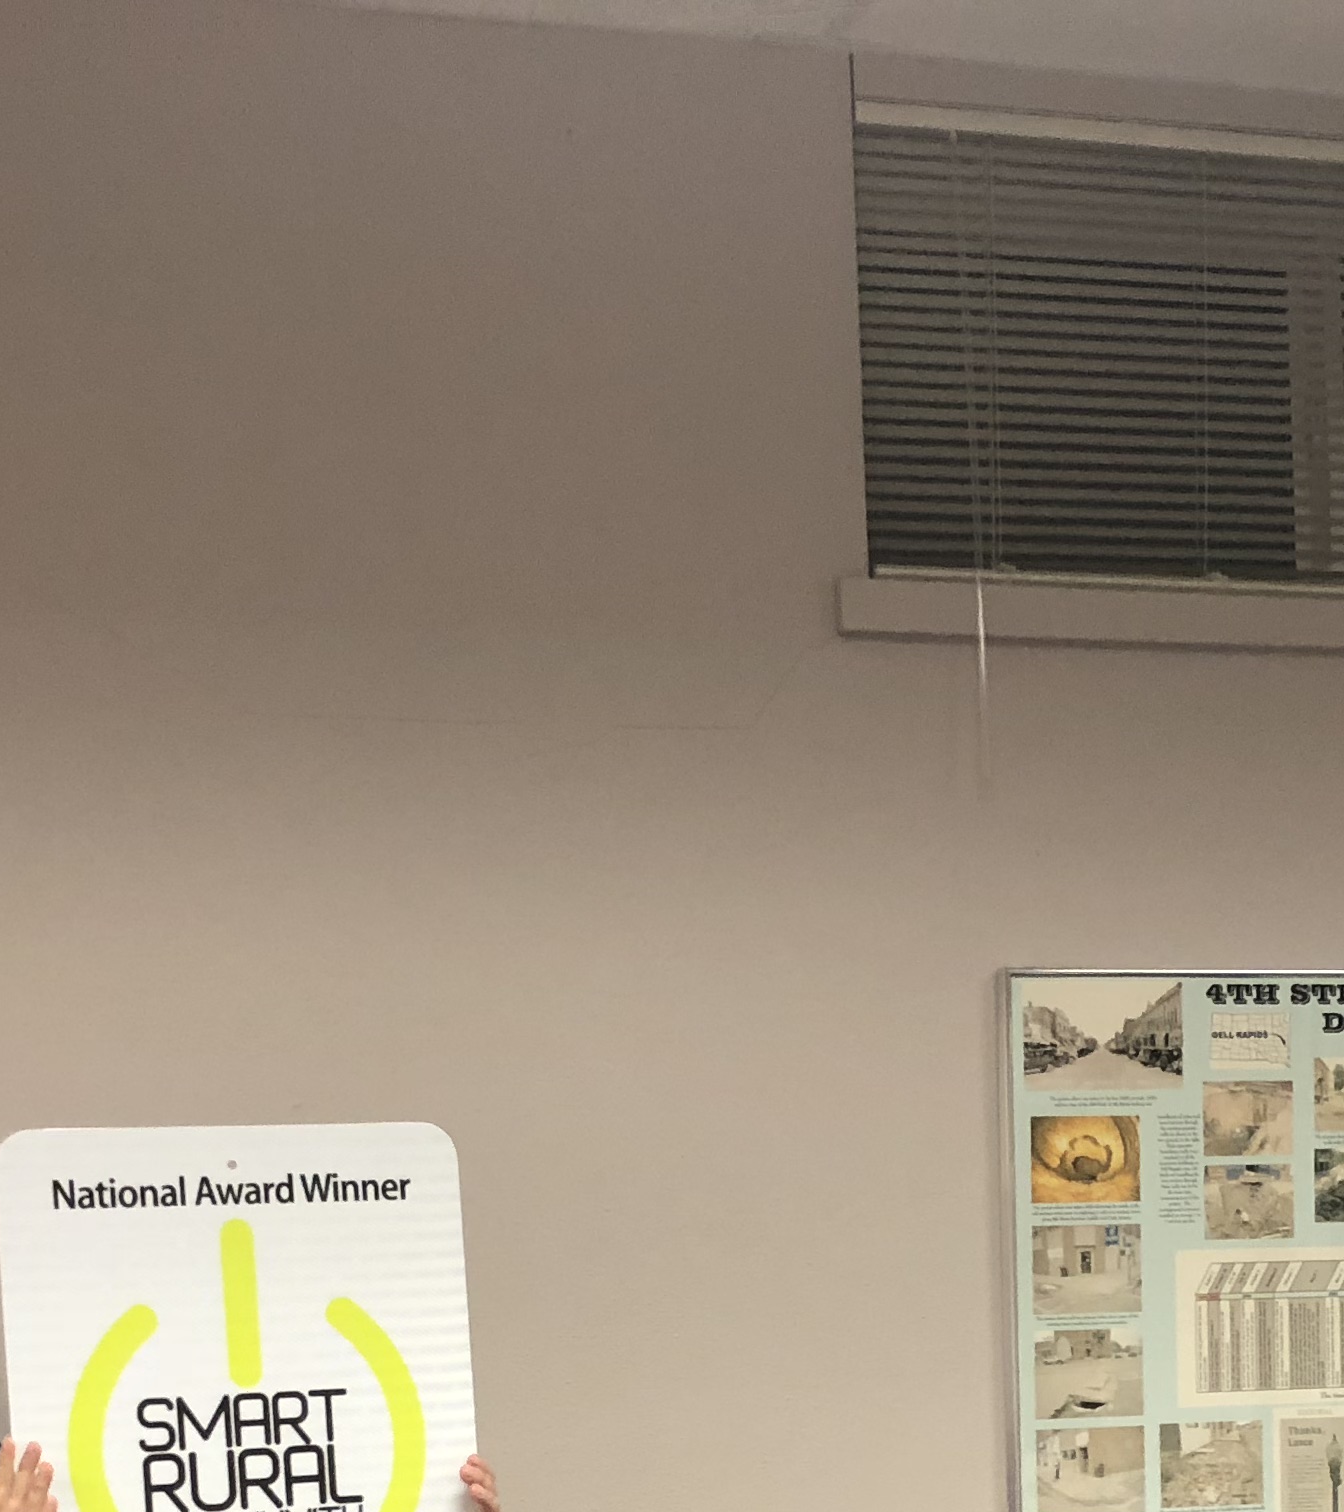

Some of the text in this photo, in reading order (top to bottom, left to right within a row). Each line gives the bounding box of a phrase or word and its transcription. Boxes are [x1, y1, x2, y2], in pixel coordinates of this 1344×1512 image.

[1205, 983, 1281, 1005] 4TH
[51, 1172, 411, 1209] National Award Winner
[136, 1388, 347, 1452] SMART
